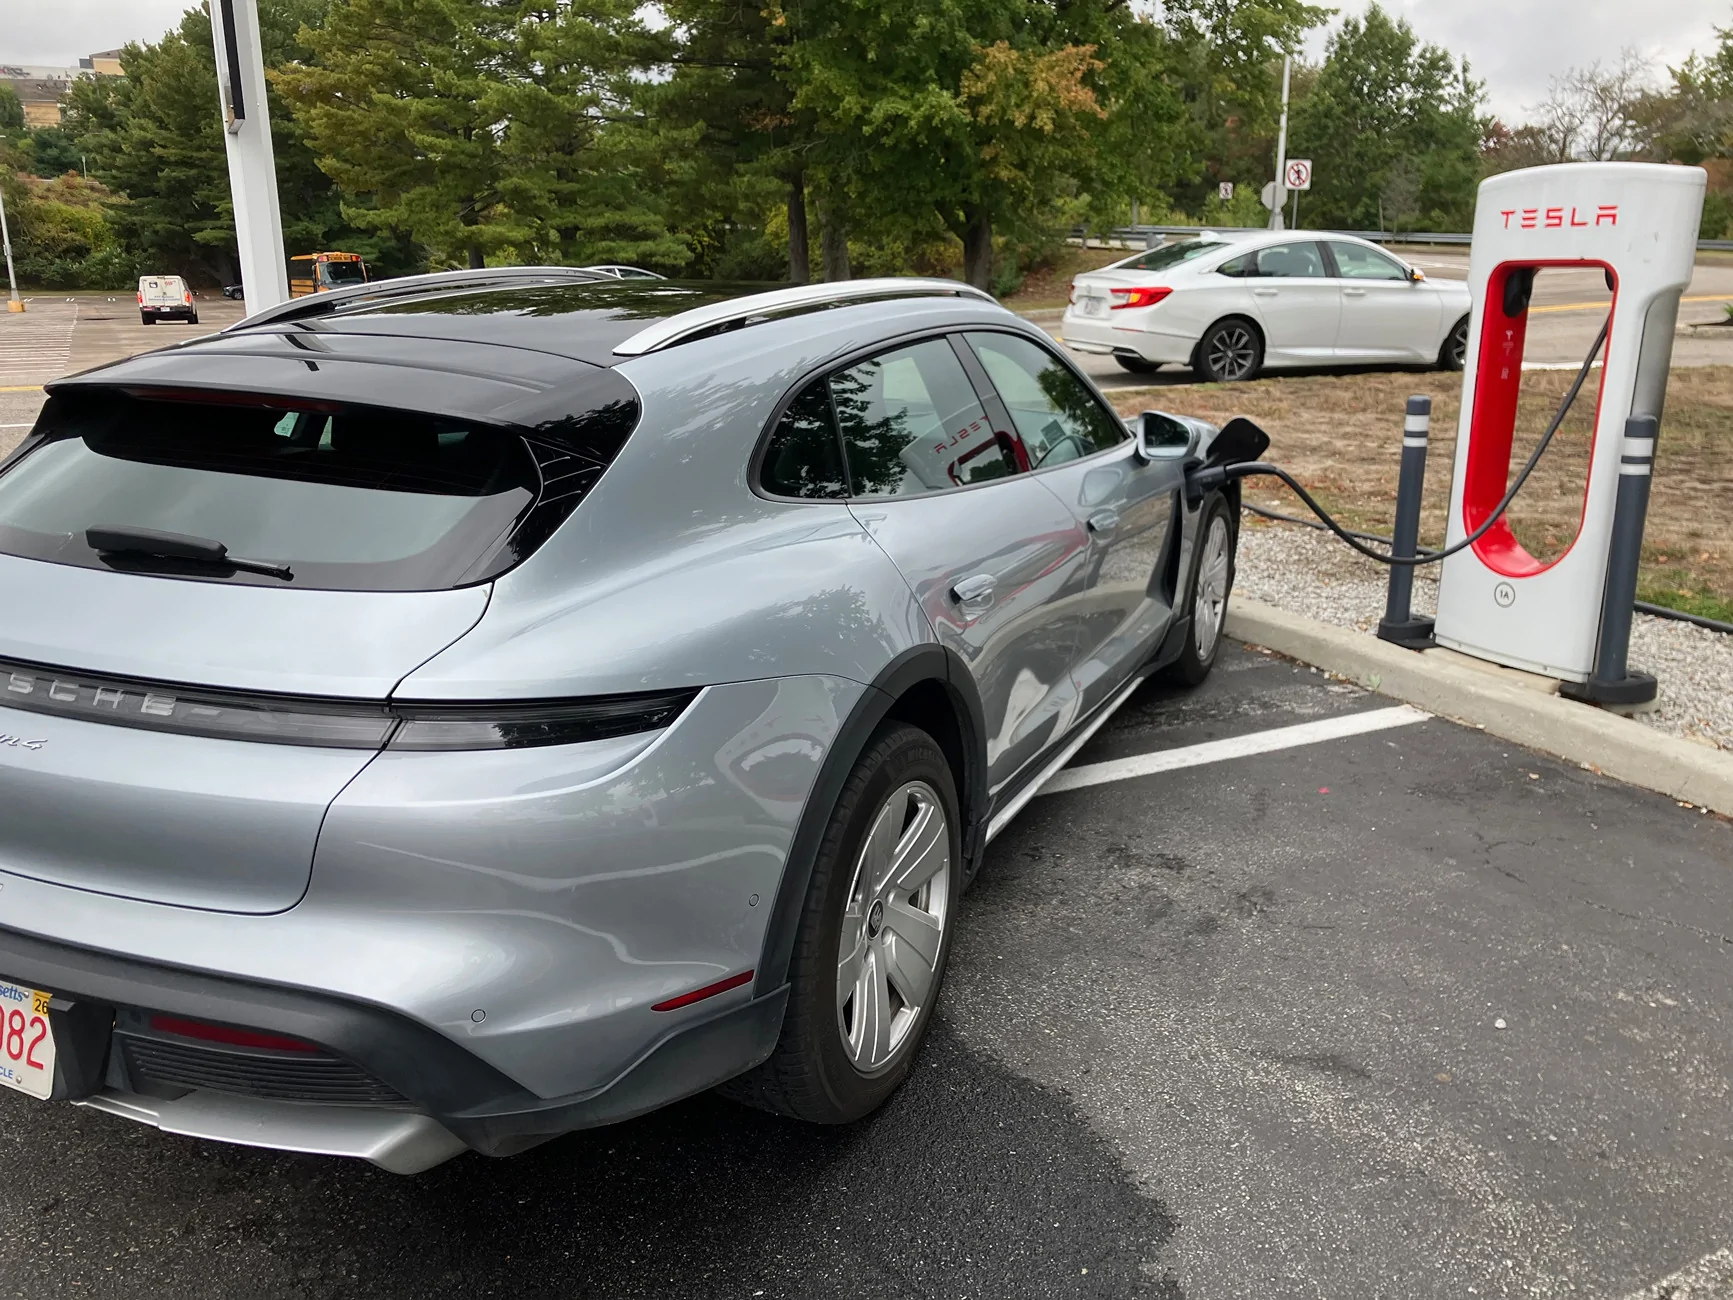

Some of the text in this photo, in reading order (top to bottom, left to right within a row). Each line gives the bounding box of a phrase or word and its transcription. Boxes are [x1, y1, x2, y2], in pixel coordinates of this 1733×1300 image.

[1500, 205, 1618, 229] TESLA
[1500, 589, 1509, 601] 1A
[7, 671, 177, 716] SCHE
[34, 998, 49, 1015] 26
[0, 1004, 47, 1071] 82
